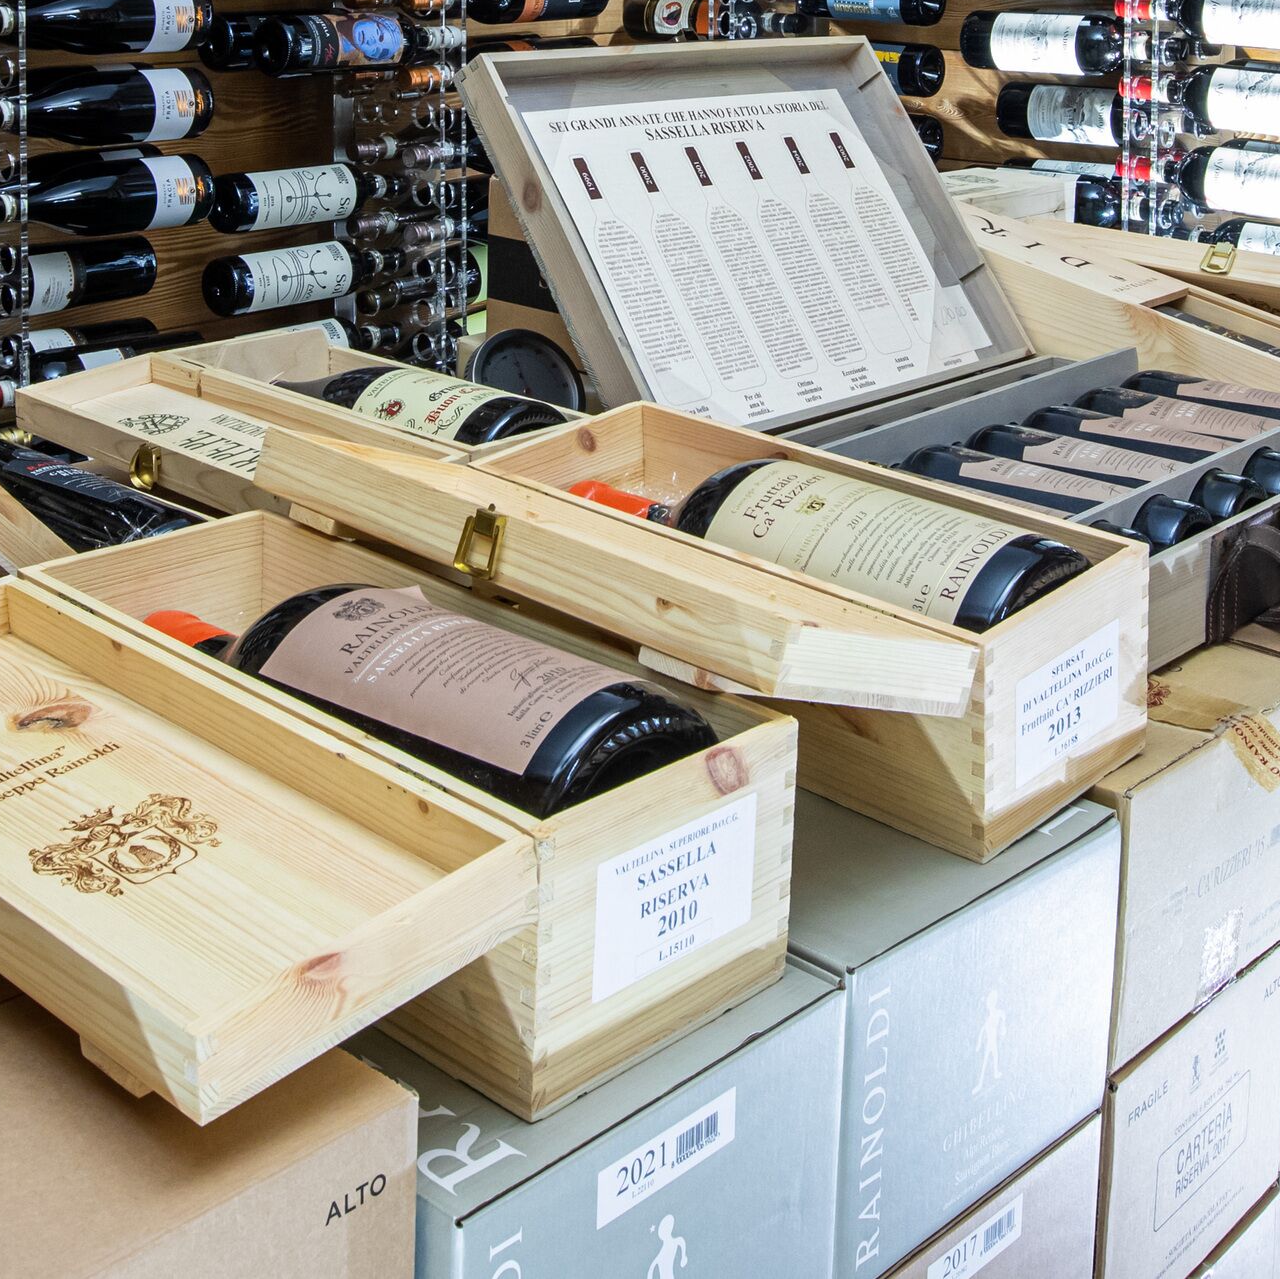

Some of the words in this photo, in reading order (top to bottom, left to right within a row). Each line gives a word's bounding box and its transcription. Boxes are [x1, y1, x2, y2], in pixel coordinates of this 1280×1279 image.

[549, 120, 570, 134] SEI
[571, 115, 618, 132] GRANDI
[619, 111, 662, 128] ANNATE
[663, 108, 687, 124] CHE
[688, 104, 726, 121] HANNO
[726, 103, 759, 119] FATTO
[760, 103, 774, 116] LA
[775, 101, 810, 115] STORIA
[811, 99, 829, 112] DEL
[645, 123, 711, 141] SASSELLA
[712, 119, 765, 137] RISERVA
[639, 165, 653, 187] 2000
[694, 159, 707, 181] 2001
[744, 154, 758, 175] 2002
[792, 148, 805, 168] 2004
[582, 171, 596, 192] 1999
[743, 473, 799, 520] Fruttaio
[847, 510, 868, 531] 2013
[939, 528, 1009, 602] RAINOLDI
[343, 622, 410, 676] VALTELLINA
[366, 629, 433, 685] SASSELLA
[1051, 649, 1086, 677] SFURSAT
[1033, 669, 1082, 705] VALTELLINA
[1085, 648, 1114, 673] D.O.C.G.
[1021, 705, 1055, 736] Fruttaio
[1073, 666, 1113, 702] RIZZIERI
[1048, 706, 1081, 743] 2013
[46, 741, 122, 779] Rainoldi
[615, 848, 665, 875] VALTELLINA
[669, 824, 711, 851] SUPERIORE
[712, 812, 739, 832] D.O.C.G.
[636, 841, 717, 891] SASSELLA
[640, 872, 710, 919] RISERVA
[657, 899, 698, 937] 2010
[659, 934, 695, 961] L.15110
[1127, 1080, 1169, 1128] FRAGILE
[855, 984, 891, 1272] RAINOLDI
[615, 1141, 668, 1198] 2021
[1174, 1153, 1210, 1198] RISERVA
[1212, 1129, 1232, 1162] 2017
[325, 1173, 388, 1226] ALTO
[942, 1233, 979, 1279] 2017
